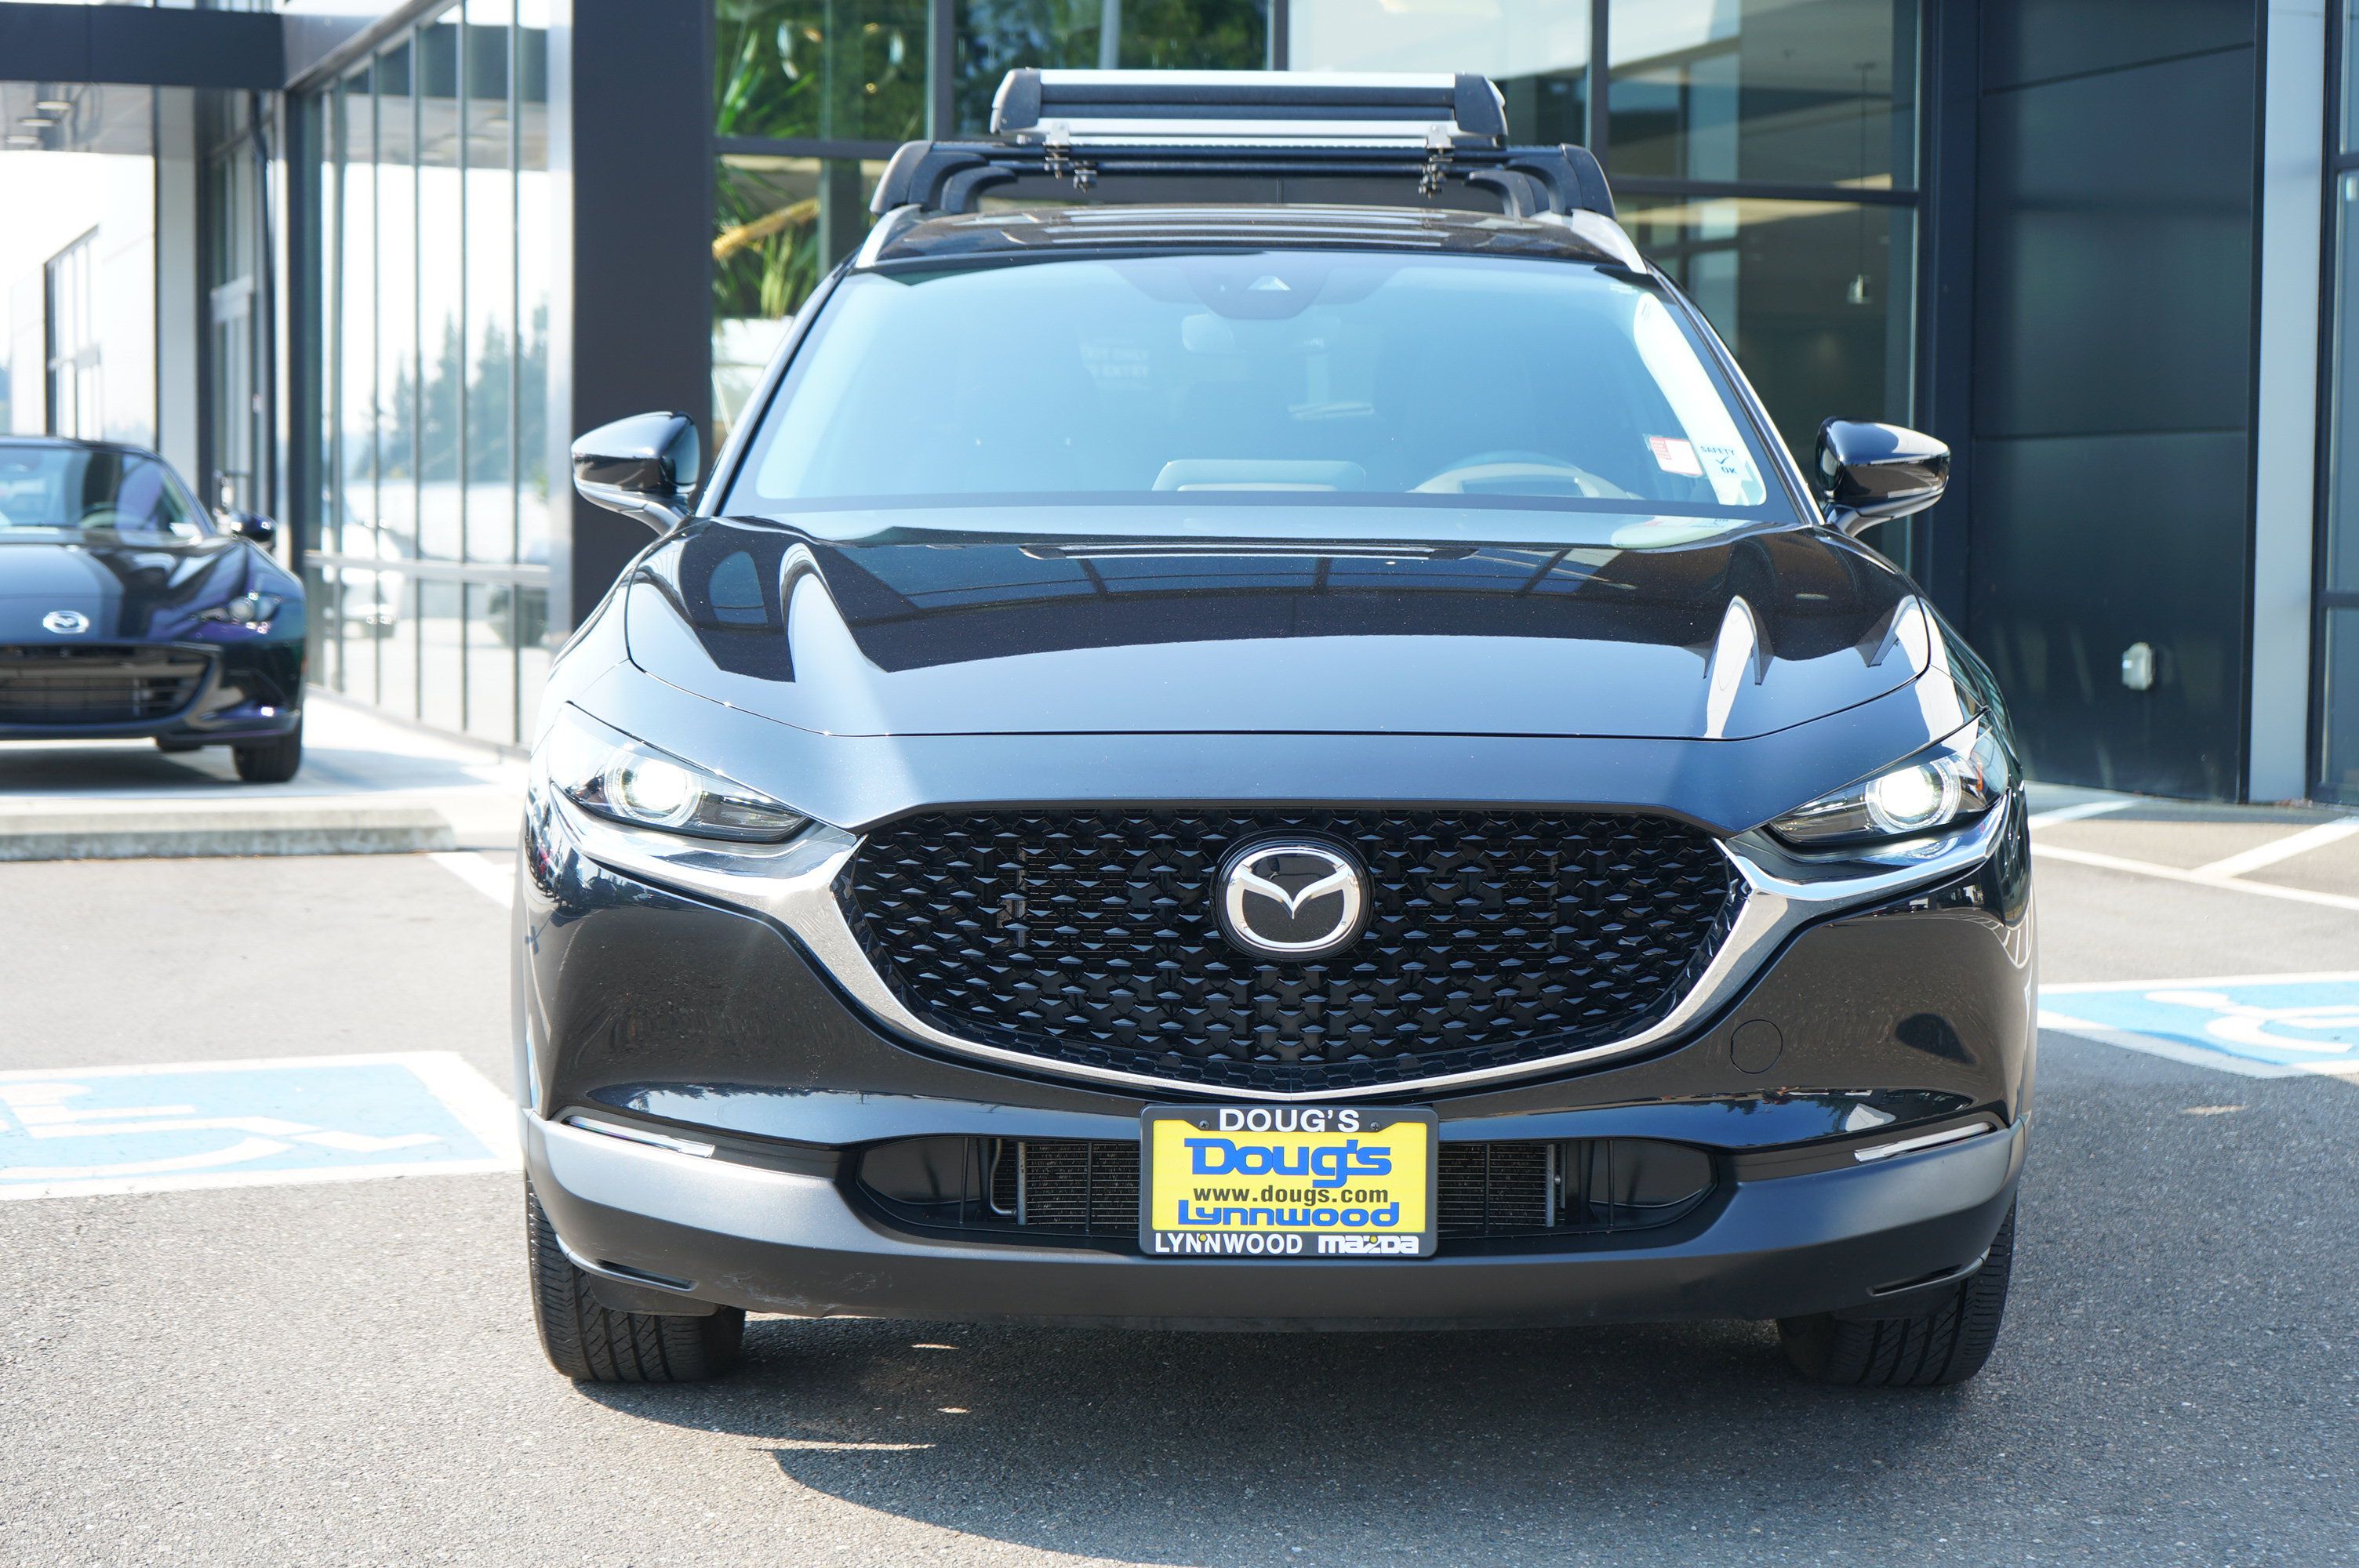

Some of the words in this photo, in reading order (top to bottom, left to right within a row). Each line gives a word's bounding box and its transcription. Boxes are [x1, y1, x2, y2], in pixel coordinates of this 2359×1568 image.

[1700, 445, 1736, 456] SAFETY
[1219, 1108, 1360, 1133] DOUG'S
[1184, 1138, 1392, 1189] Doug's
[1193, 1185, 1389, 1207] www.dougs.com
[1178, 1200, 1400, 1228] Lynnwood
[1154, 1232, 1303, 1254] LYNNWOOD
